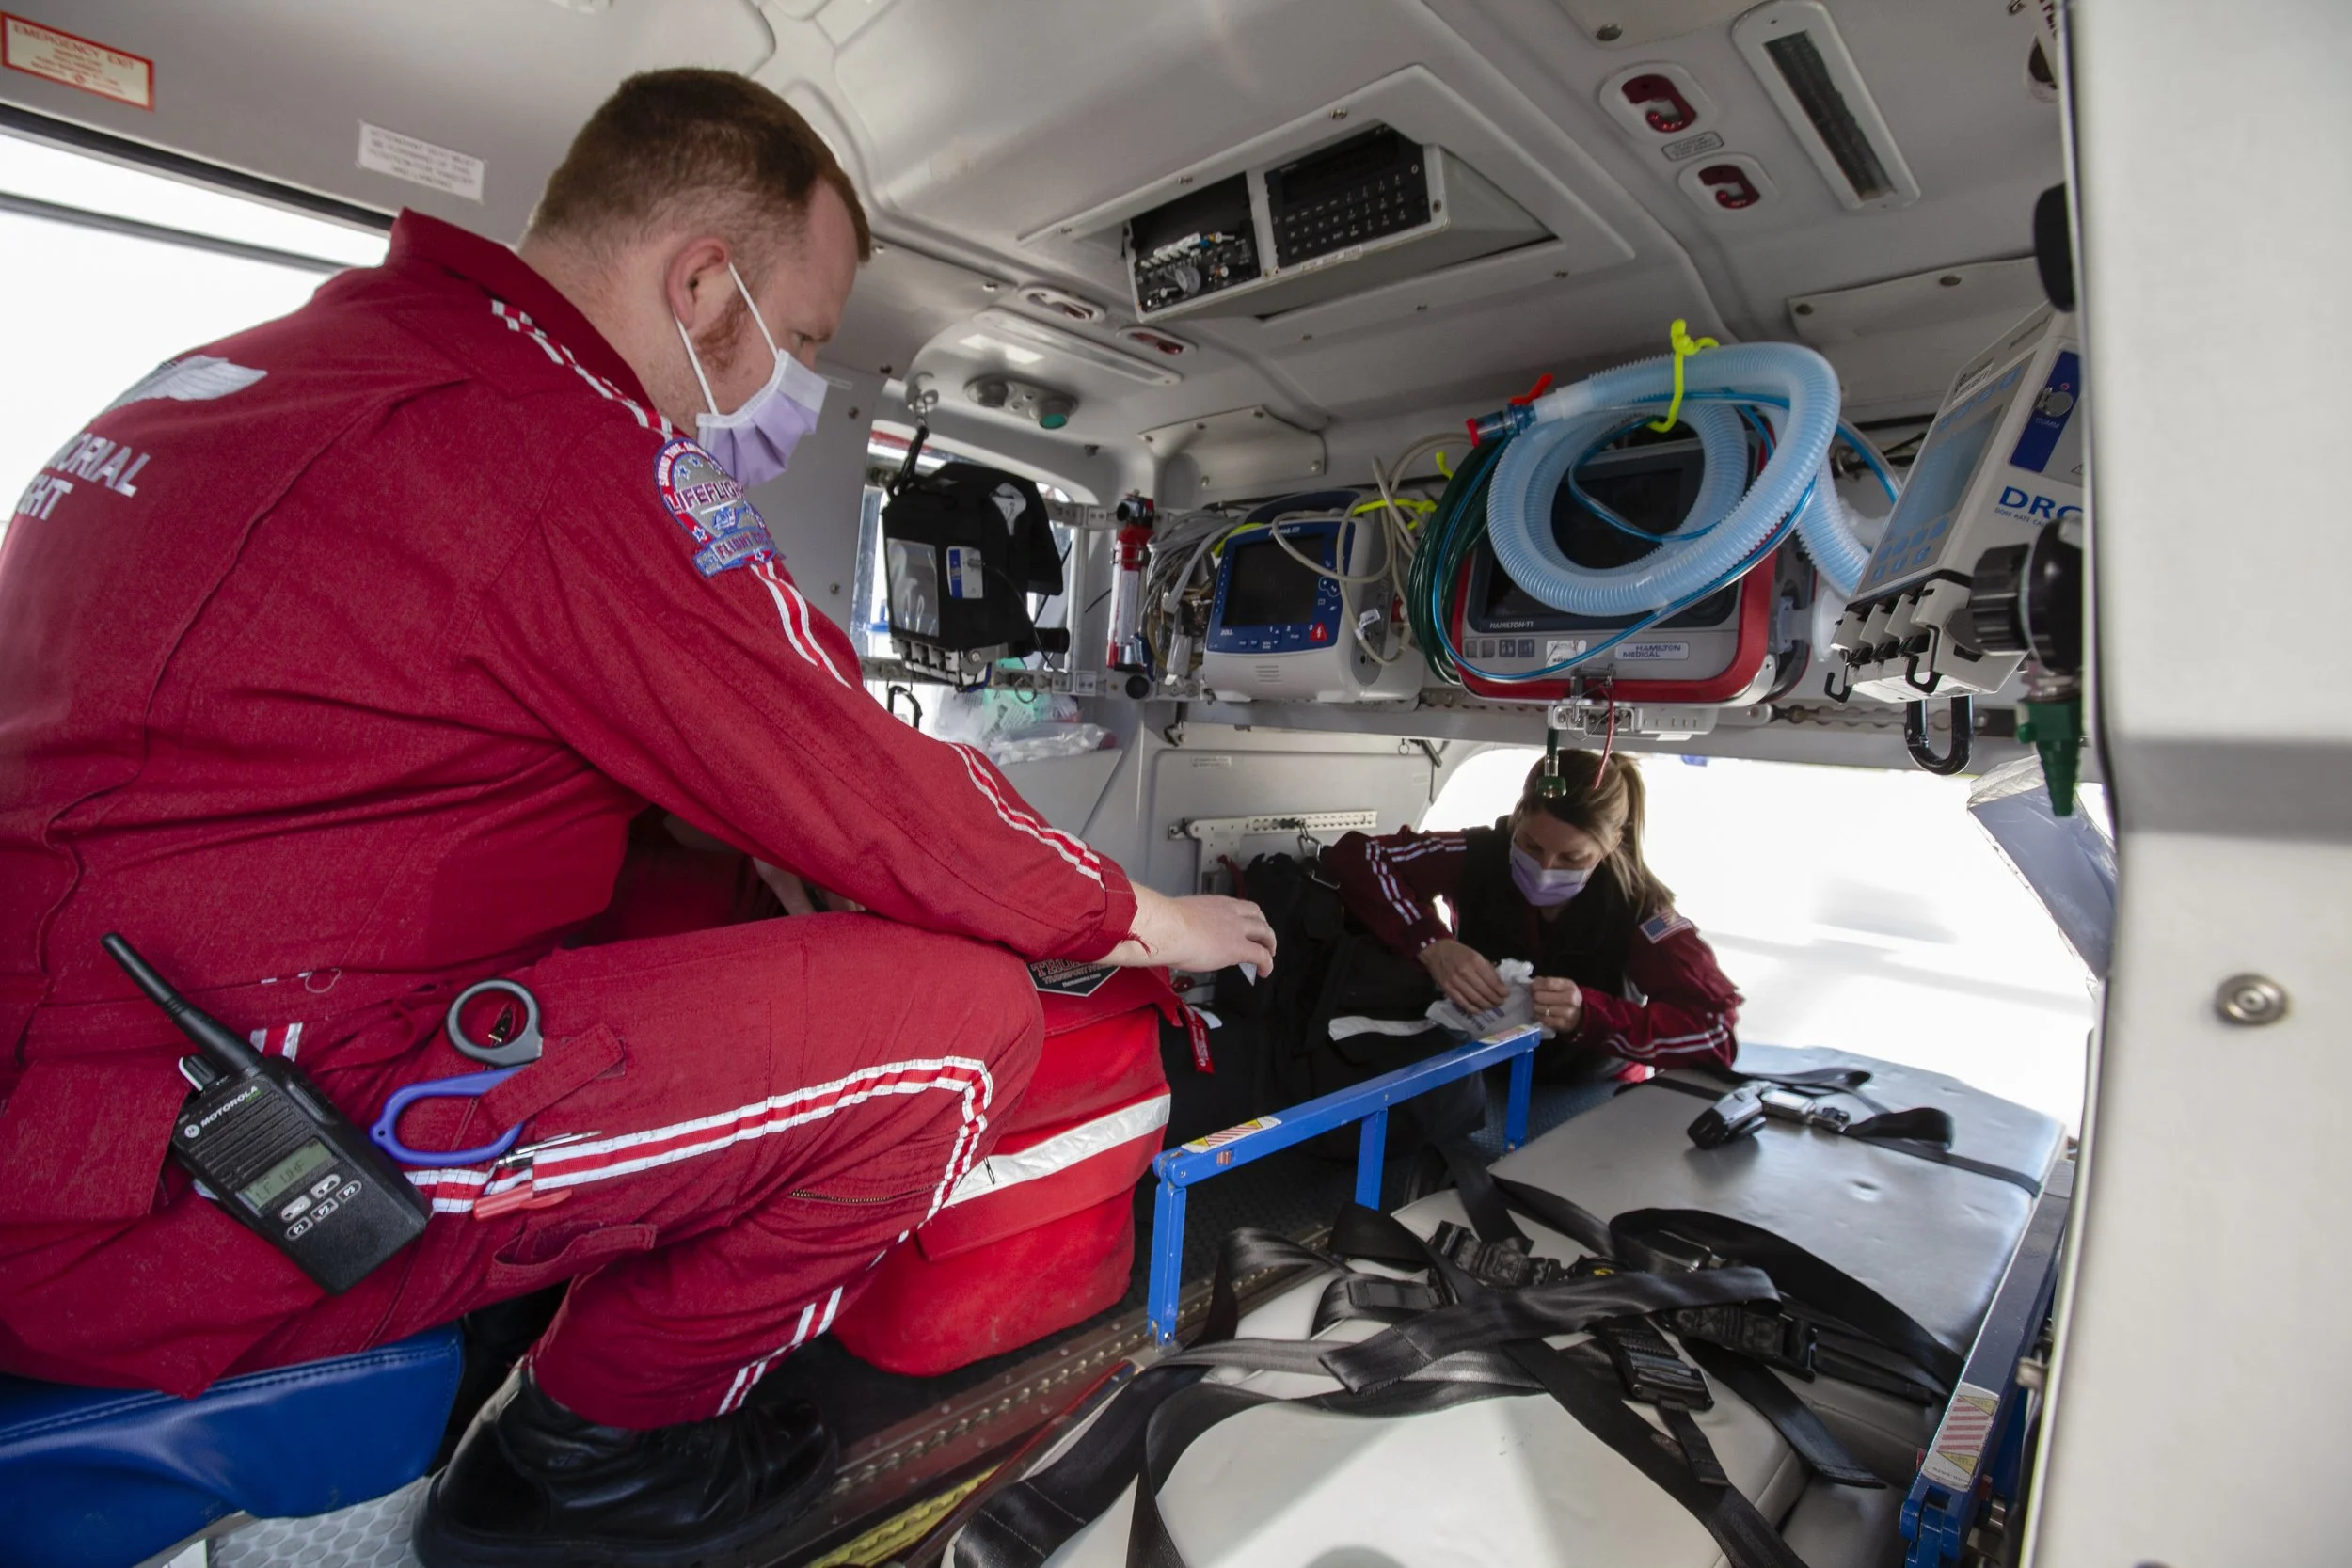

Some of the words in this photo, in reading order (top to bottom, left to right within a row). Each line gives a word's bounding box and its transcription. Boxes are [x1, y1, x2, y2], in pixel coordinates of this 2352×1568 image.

[43, 432, 151, 499] ORIAL
[664, 481, 743, 514] LIFEFLIGH
[200, 1085, 259, 1128] MOTOROLA
